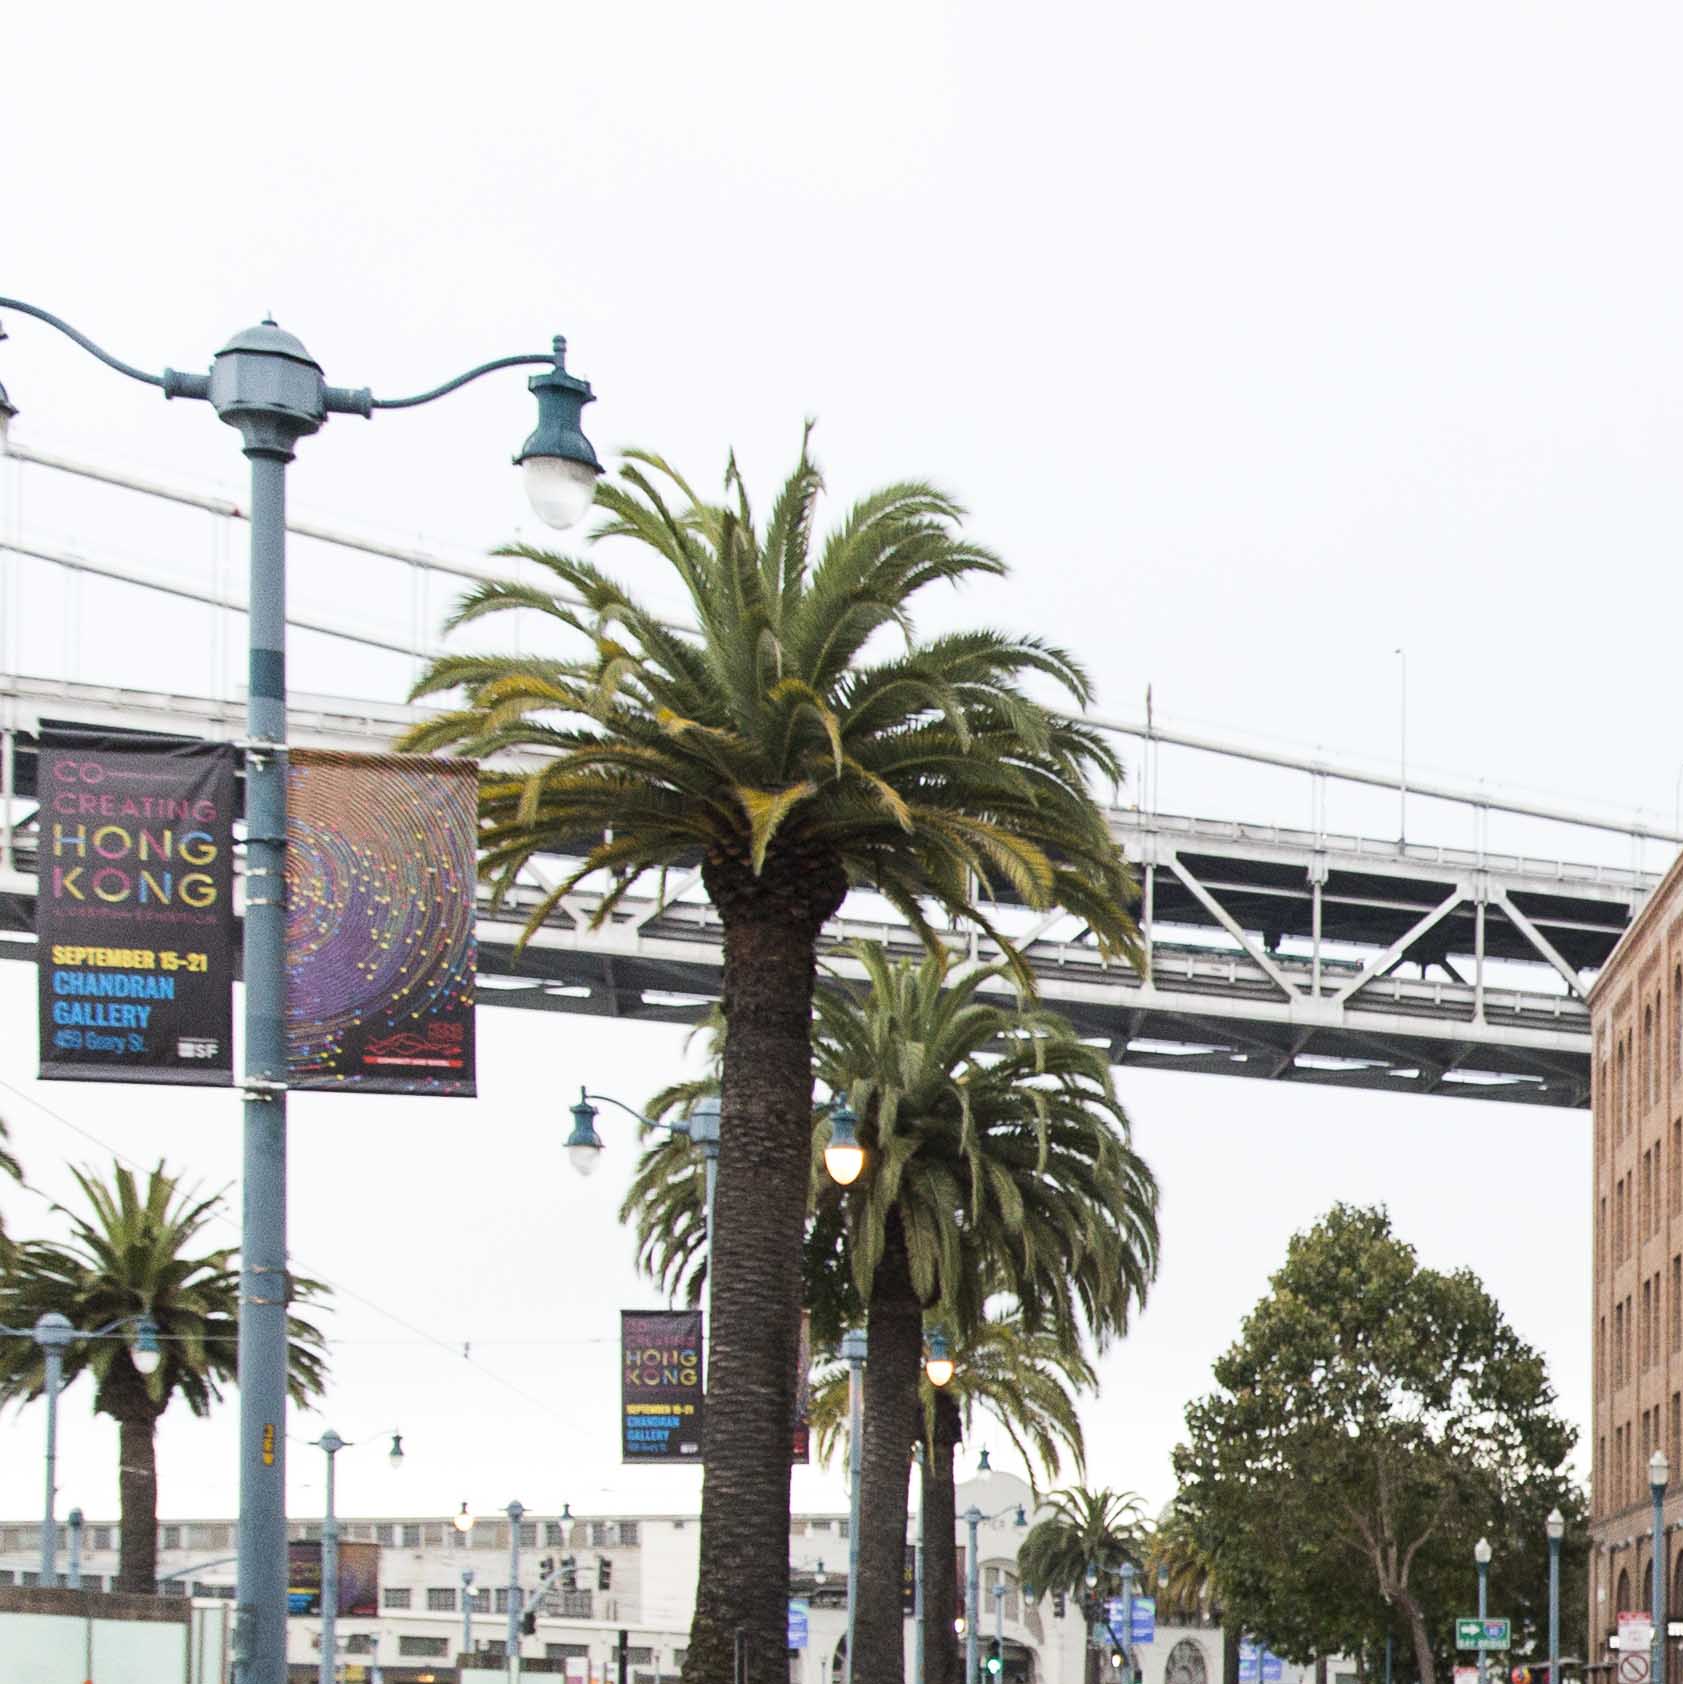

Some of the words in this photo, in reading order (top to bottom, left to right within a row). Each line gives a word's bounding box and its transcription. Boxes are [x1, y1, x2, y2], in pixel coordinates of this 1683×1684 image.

[53, 792, 217, 823] CREATING
[53, 823, 218, 866] HONG
[52, 865, 218, 907] KONG
[52, 944, 156, 970] SEPTEMBER
[52, 969, 176, 1001] CHANDRAN
[52, 1000, 151, 1029] GALLERY
[626, 1349, 698, 1367] HONG
[625, 1367, 698, 1387] KONG
